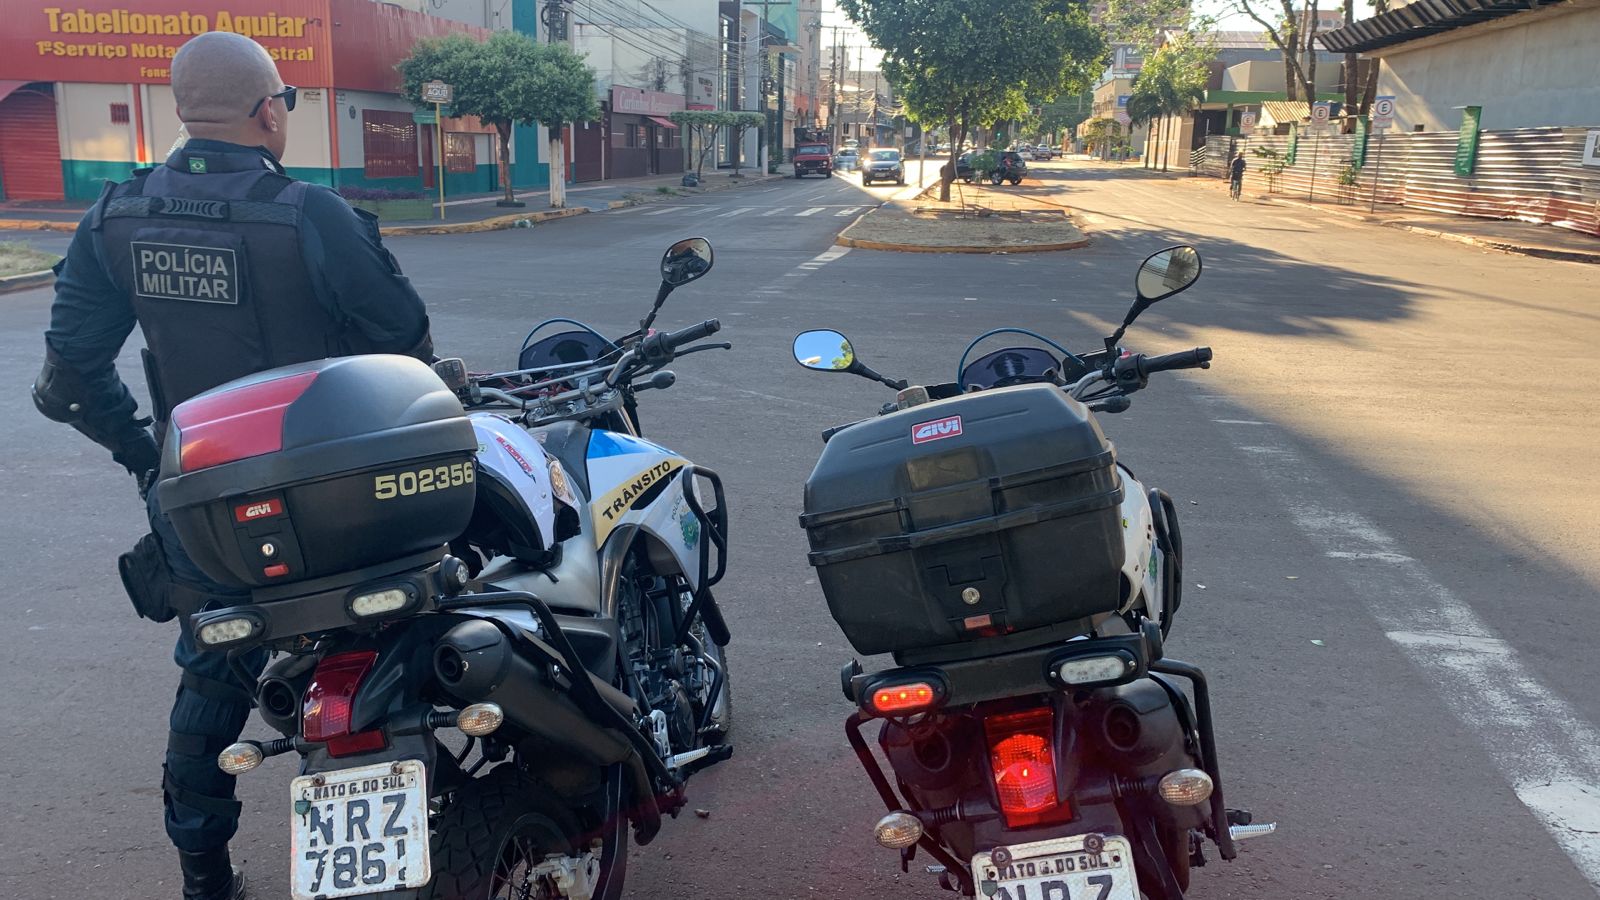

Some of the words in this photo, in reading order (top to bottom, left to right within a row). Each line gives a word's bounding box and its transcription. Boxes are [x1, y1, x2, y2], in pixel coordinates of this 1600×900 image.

[43, 7, 209, 35] Tabelionato
[215, 11, 307, 37] Aguiar
[1381, 103, 1388, 112] E
[140, 249, 228, 276] POLÍCIA
[142, 272, 229, 299] MILITAR
[915, 419, 959, 438] GIVI
[375, 461, 474, 499] 502356
[602, 461, 671, 520] TRÂNSITO
[245, 503, 271, 517] GIVI
[313, 783, 346, 799] MATO
[382, 775, 405, 789] SUL
[309, 793, 408, 847] NRZ
[305, 838, 406, 893] 7861
[1079, 854, 1109, 870] SUL
